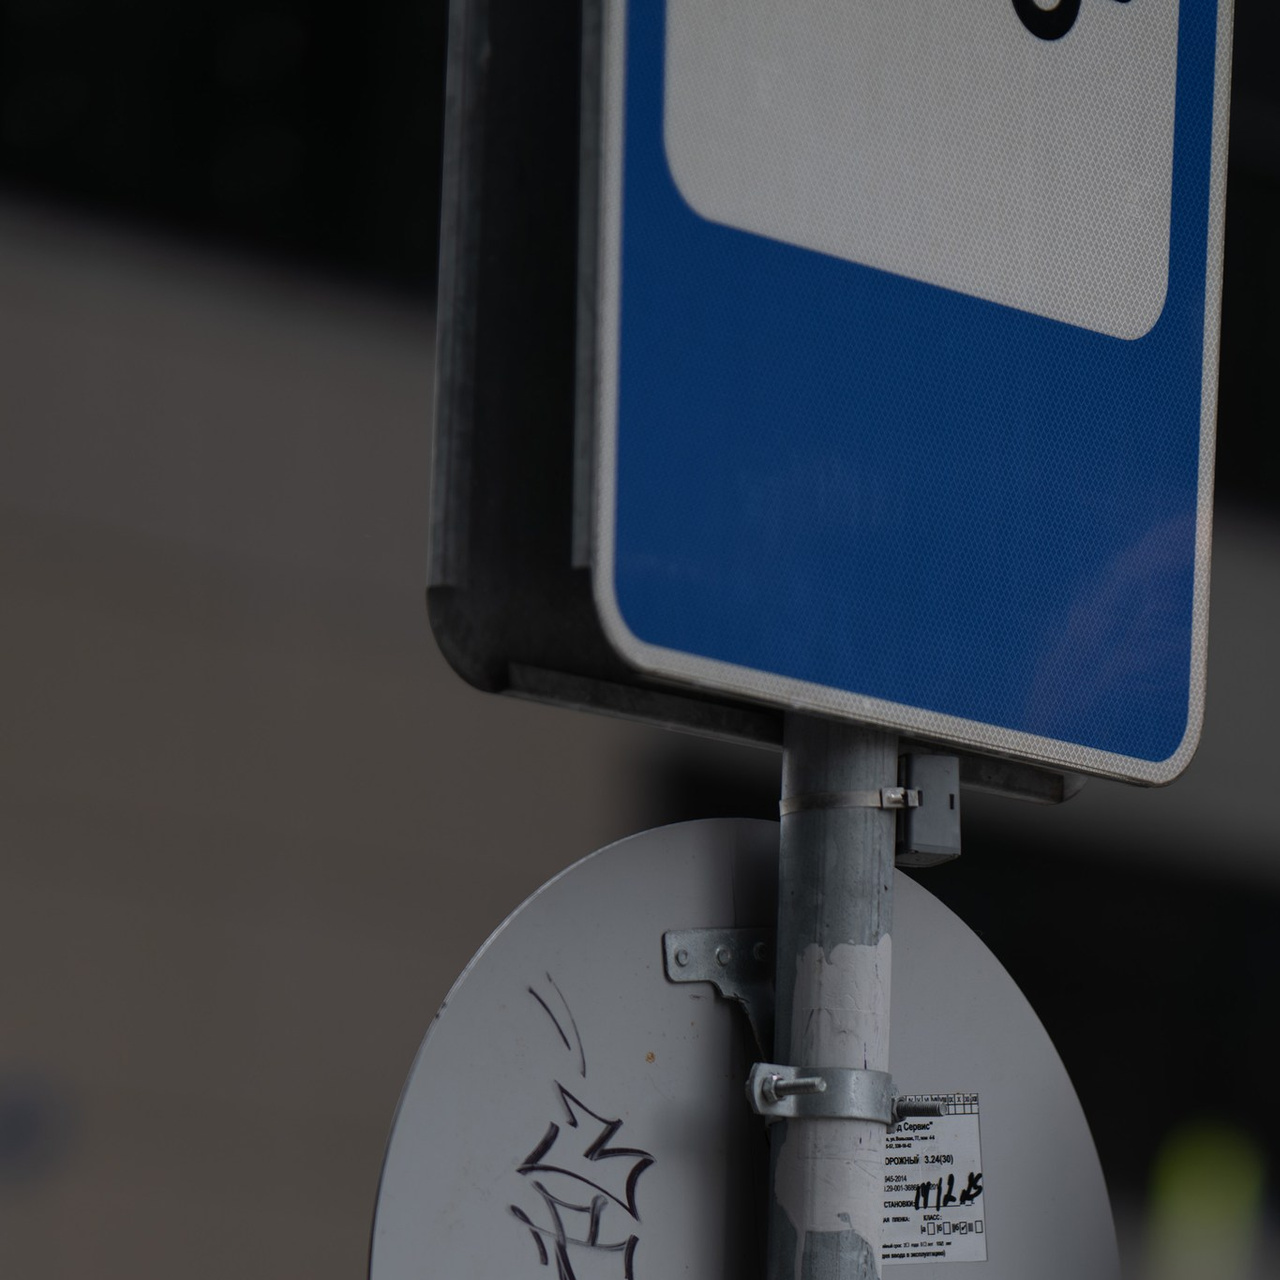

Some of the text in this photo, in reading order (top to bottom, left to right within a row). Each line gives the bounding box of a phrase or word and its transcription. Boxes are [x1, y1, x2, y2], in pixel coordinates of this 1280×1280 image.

[885, 1154, 954, 1166] ОРОЖНЫЙ 3.24(30)
[884, 1200, 916, 1209] СТАНОВКИ:
